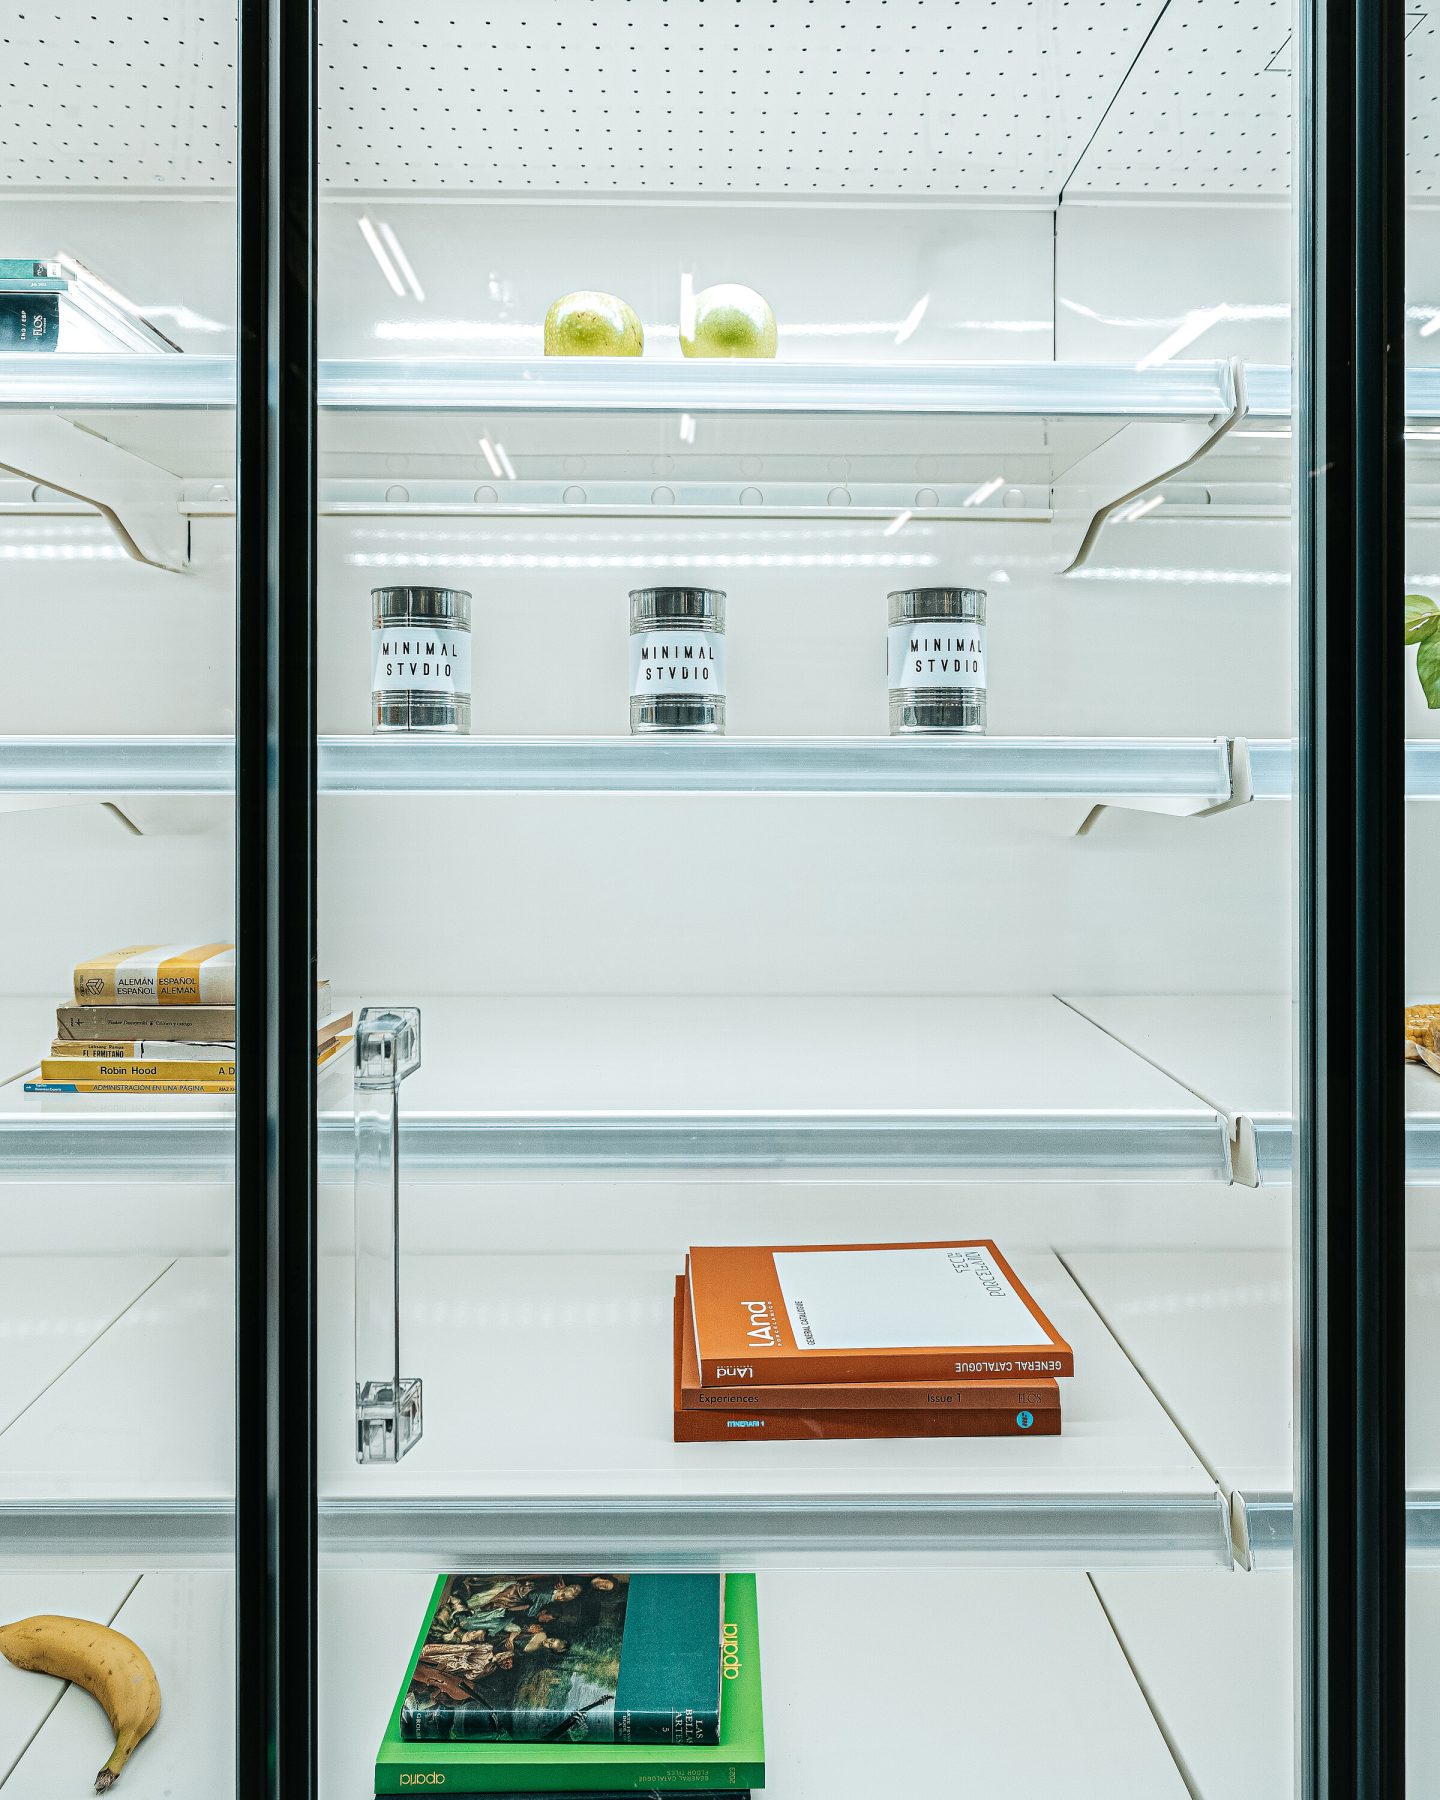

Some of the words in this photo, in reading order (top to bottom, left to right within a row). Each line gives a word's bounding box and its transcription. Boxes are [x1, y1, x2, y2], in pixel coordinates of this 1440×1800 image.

[33, 314, 43, 336] FLOS
[382, 642, 458, 657] MINIMAL
[641, 645, 715, 660] MINIMAL
[910, 638, 982, 653] MINIMAL
[386, 662, 452, 677] STVDIO
[646, 666, 709, 680] STVDIO
[915, 659, 978, 673] STVDIO
[118, 976, 154, 986] ALEMÁN
[159, 976, 197, 986] ESPAÑOL
[117, 986, 156, 995] ESPAÑOL
[160, 986, 196, 995] ALEMÁN
[93, 1050, 124, 1058] ERMITAÑO
[101, 1066, 127, 1075] Robin
[131, 1066, 157, 1075] Hood
[794, 1300, 809, 1326] CATALOGUE
[802, 1325, 816, 1346] GENERAL
[955, 1361, 1013, 1373] CATALOGUE
[1015, 1360, 1062, 1372] GENERAL
[699, 1393, 759, 1405] Experiences
[927, 1393, 953, 1403] Issue
[957, 1393, 962, 1403] 1
[1018, 1393, 1042, 1403] FLOS
[723, 1624, 743, 1680] aparici
[675, 1710, 683, 1743] ARTES
[685, 1708, 693, 1744] BELLAS
[695, 1719, 704, 1739] LAS
[400, 1771, 446, 1786] aparici
